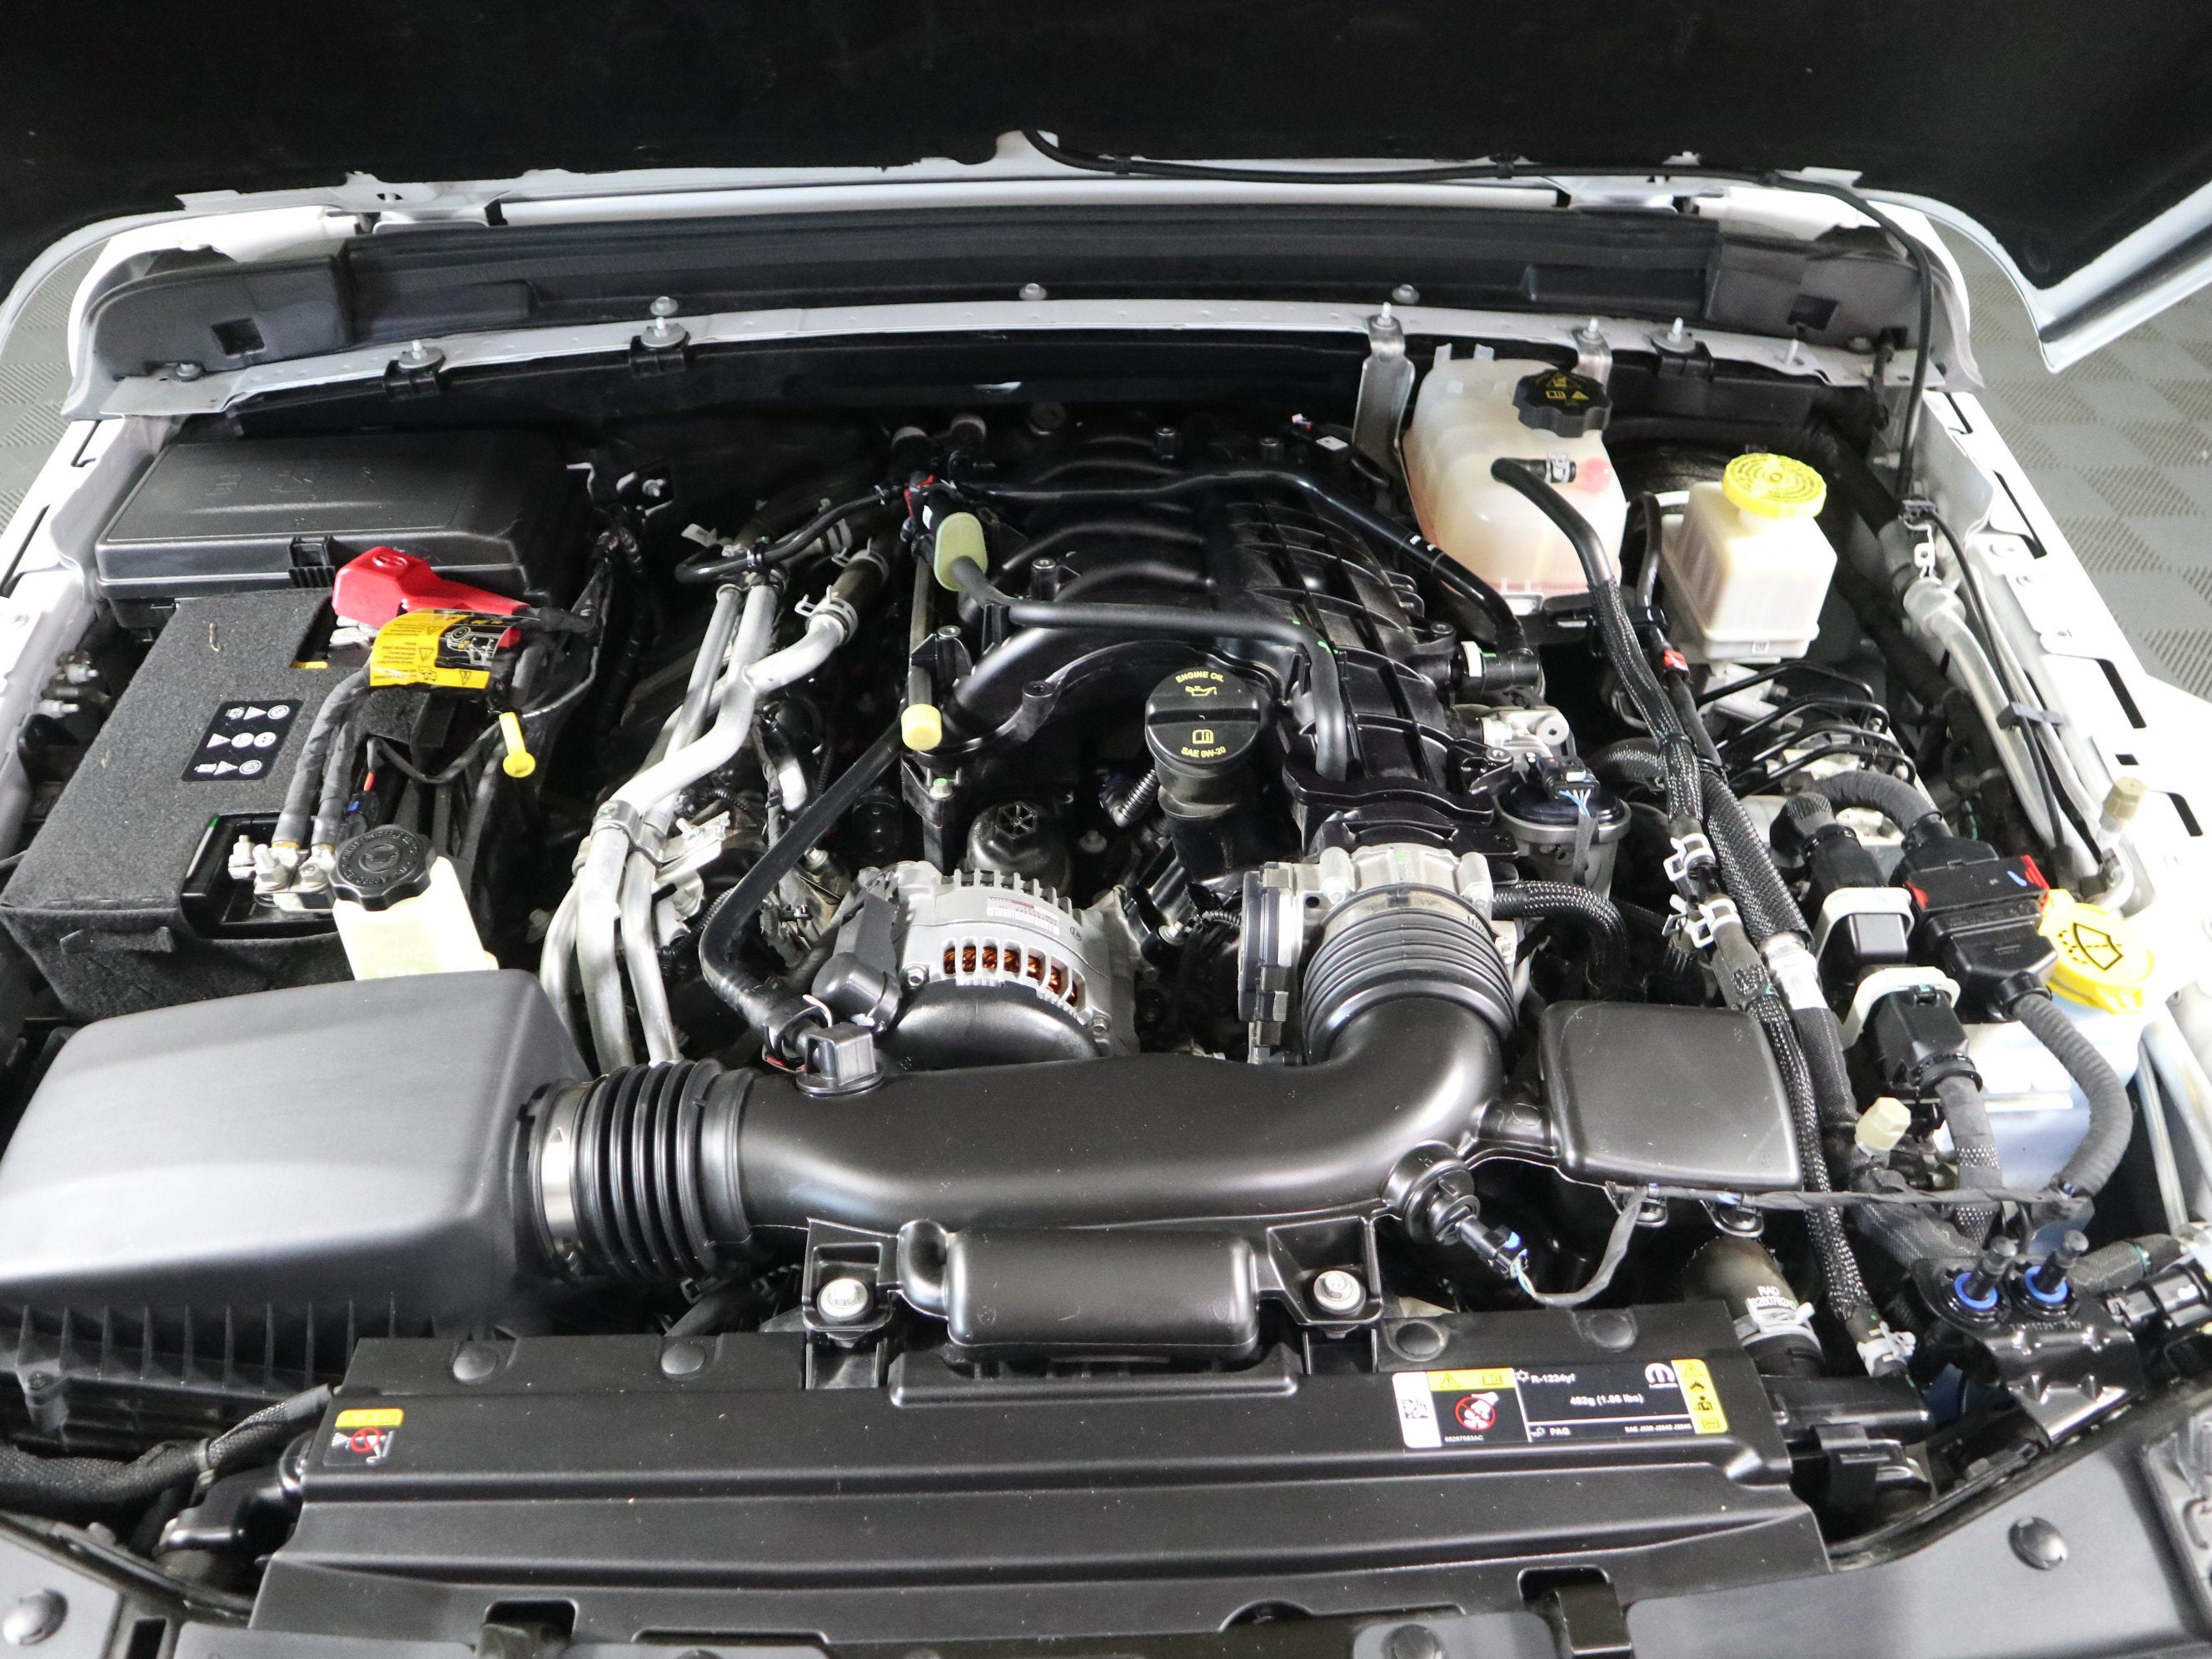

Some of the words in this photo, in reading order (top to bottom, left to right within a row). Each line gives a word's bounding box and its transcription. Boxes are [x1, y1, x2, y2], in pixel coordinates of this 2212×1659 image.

[1175, 670, 1208, 683] ENGINE
[1210, 673, 1224, 682] OIL
[1181, 746, 1199, 758] SAE
[1200, 745, 1227, 758] 0W-20
[1757, 1286, 1781, 1296] RAD
[1530, 1373, 1576, 1383] R-1234yf
[1623, 1393, 1645, 1404] lbs)
[1550, 1427, 1572, 1436] PAG
